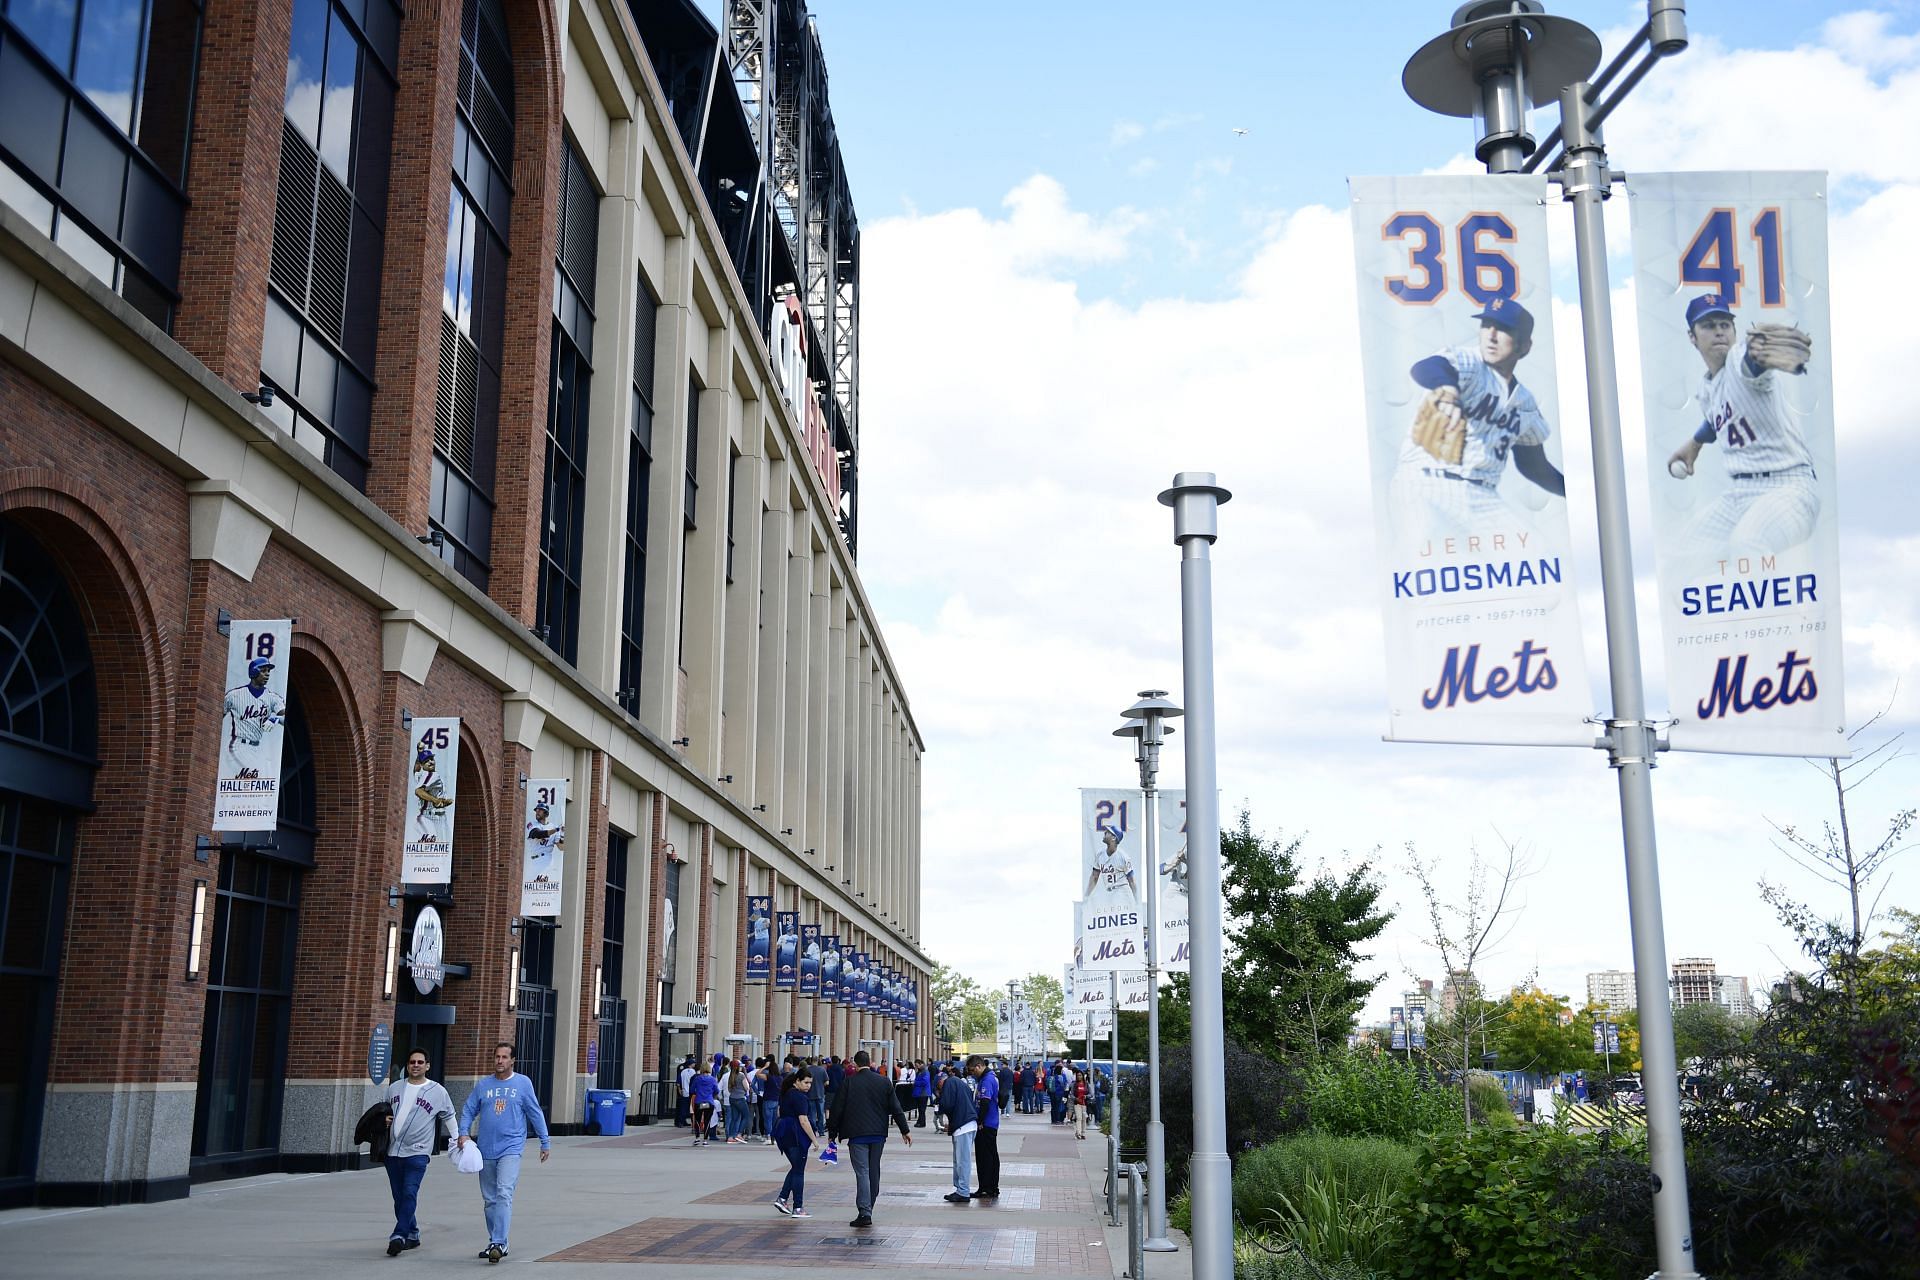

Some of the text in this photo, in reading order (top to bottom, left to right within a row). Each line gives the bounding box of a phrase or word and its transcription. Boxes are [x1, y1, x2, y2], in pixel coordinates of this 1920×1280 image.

[1381, 211, 1521, 307] 36
[1679, 207, 1786, 308] 41
[1728, 416, 1757, 447] 41
[1420, 532, 1530, 557] JERRY
[1717, 555, 1777, 576] TOM
[1393, 557, 1562, 598] KOOSMAN
[1682, 573, 1818, 616] SEAVER
[1416, 614, 1472, 628] PITCHER
[1677, 632, 1729, 645] PITCHER
[1799, 621, 1827, 633] 1983
[245, 632, 275, 660] 18
[1421, 639, 1559, 711] Mets
[1696, 650, 1819, 720] Mets
[240, 704, 268, 720] Mets
[421, 728, 449, 749] 45
[235, 768, 259, 779] Mets
[220, 780, 242, 791] HALL
[250, 780, 276, 791] FAME
[538, 787, 556, 805] 31
[218, 810, 273, 818] STRAWBERRY
[1096, 800, 1128, 832] 21
[417, 834, 437, 843] Mets
[406, 844, 423, 852] HALL
[430, 844, 449, 852] FAME
[1107, 875, 1117, 883] 21
[752, 899, 768, 911] 34
[782, 914, 794, 925] 13
[1087, 912, 1138, 930] JONES
[1164, 918, 1190, 929] KRAN
[1092, 938, 1136, 962] Mets
[411, 966, 441, 980] TEAM STORE
[1075, 975, 1108, 984] HERNANDEZ
[1122, 974, 1148, 985] WILSO
[1079, 990, 1105, 1004] Mets
[487, 1087, 518, 1098] METS
[416, 1097, 434, 1115] YORK
